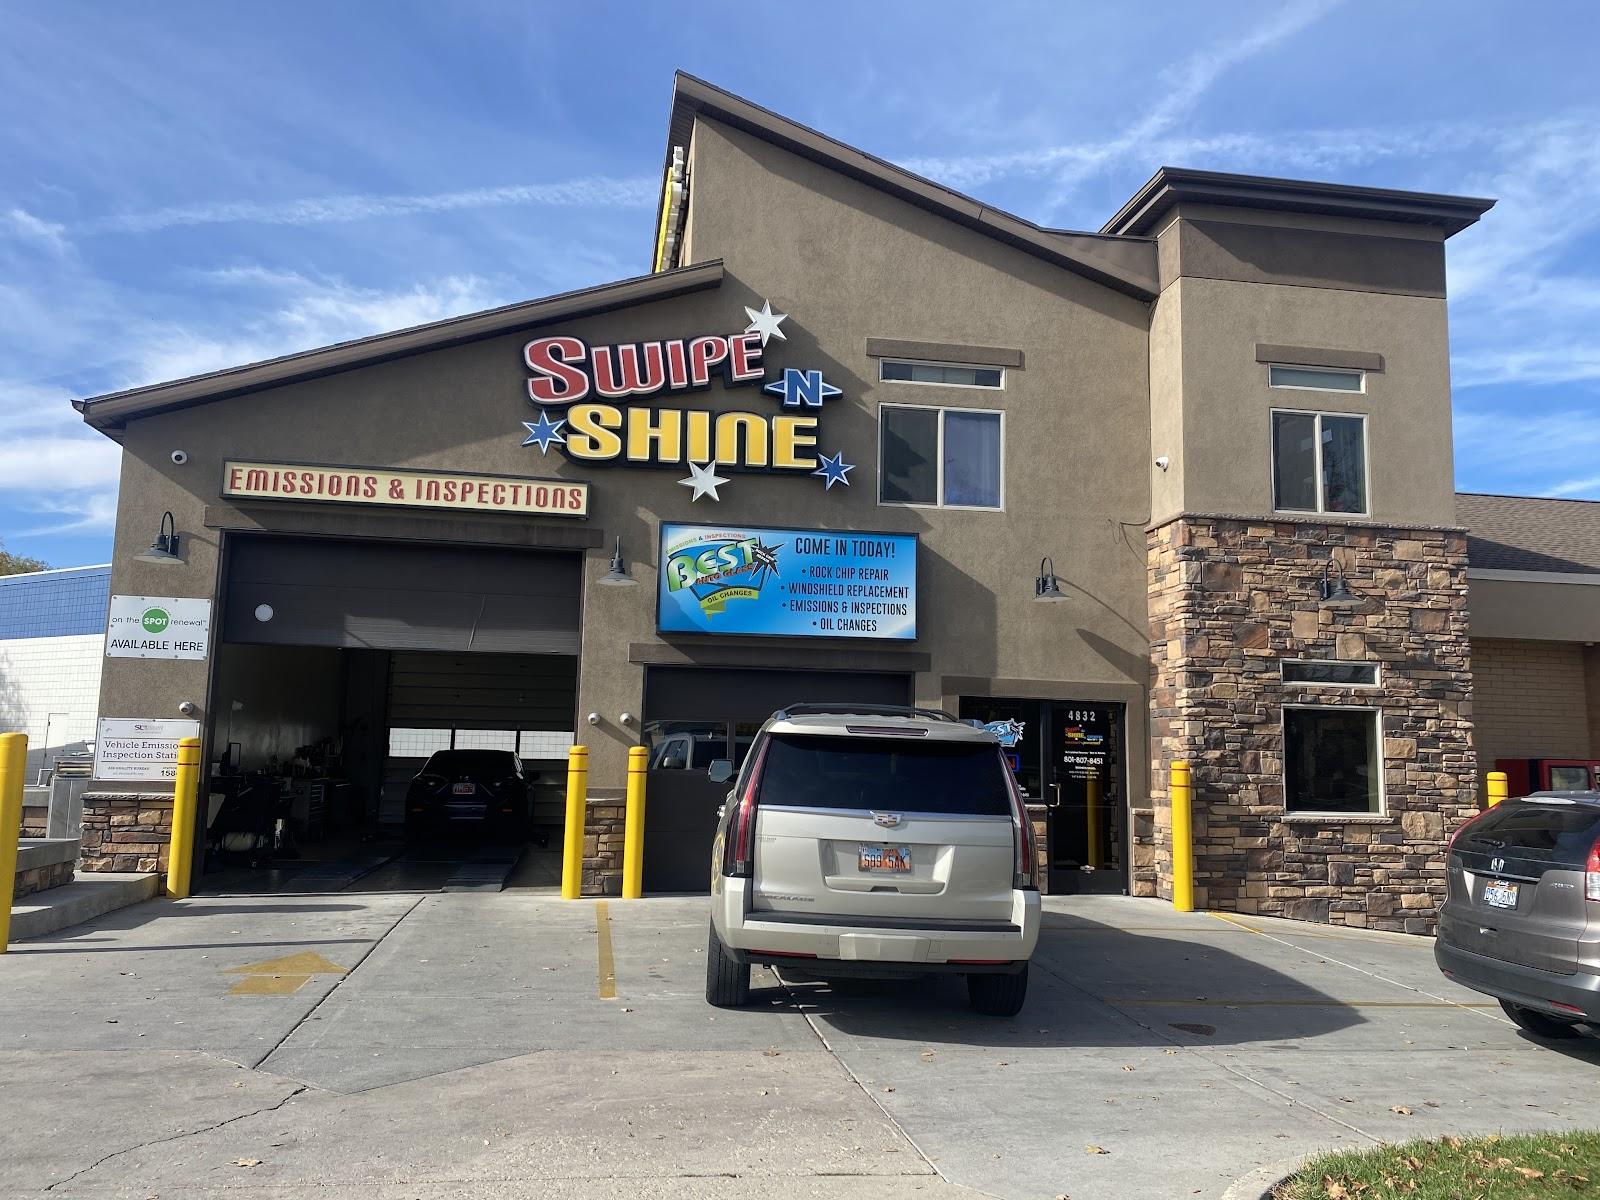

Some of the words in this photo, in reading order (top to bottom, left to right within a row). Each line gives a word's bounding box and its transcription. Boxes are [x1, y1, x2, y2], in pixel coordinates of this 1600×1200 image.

[524, 331, 766, 405] SWIPE
[783, 367, 823, 407] N
[566, 403, 818, 469] SHINE
[229, 468, 379, 499] EMISSIONS
[388, 478, 405, 500] &
[415, 479, 583, 510] INSPECTIONS
[665, 538, 697, 554] EMISSIONS
[795, 537, 831, 555] COME
[835, 539, 847, 556] IN
[851, 540, 895, 559] TODAY!
[666, 537, 759, 592] BEST
[695, 572, 720, 585] AUTO
[809, 565, 832, 578] ROCK
[835, 567, 856, 579] CHIP
[858, 568, 889, 580] REPAIR
[707, 595, 719, 604] OIL
[719, 590, 752, 599] CHANGES
[788, 582, 844, 596] WINDSHIELD
[847, 584, 909, 599] REPLACEMENT
[790, 599, 839, 613] EMISSIONS
[841, 602, 848, 613] &
[851, 602, 907, 616] INSPECTIONS
[126, 616, 140, 624] the
[143, 617, 168, 626] SPOT
[820, 618, 834, 630] OIL
[837, 618, 877, 632] CHANGES
[110, 639, 170, 650] AVAILABLE
[174, 641, 204, 652] HERE
[1068, 710, 1096, 722] 4832
[104, 741, 140, 749] Vehicle
[141, 741, 179, 750] Emissio
[102, 750, 153, 760] Inspection
[155, 751, 179, 759] Stati
[1063, 755, 1104, 765] 801-807-8451
